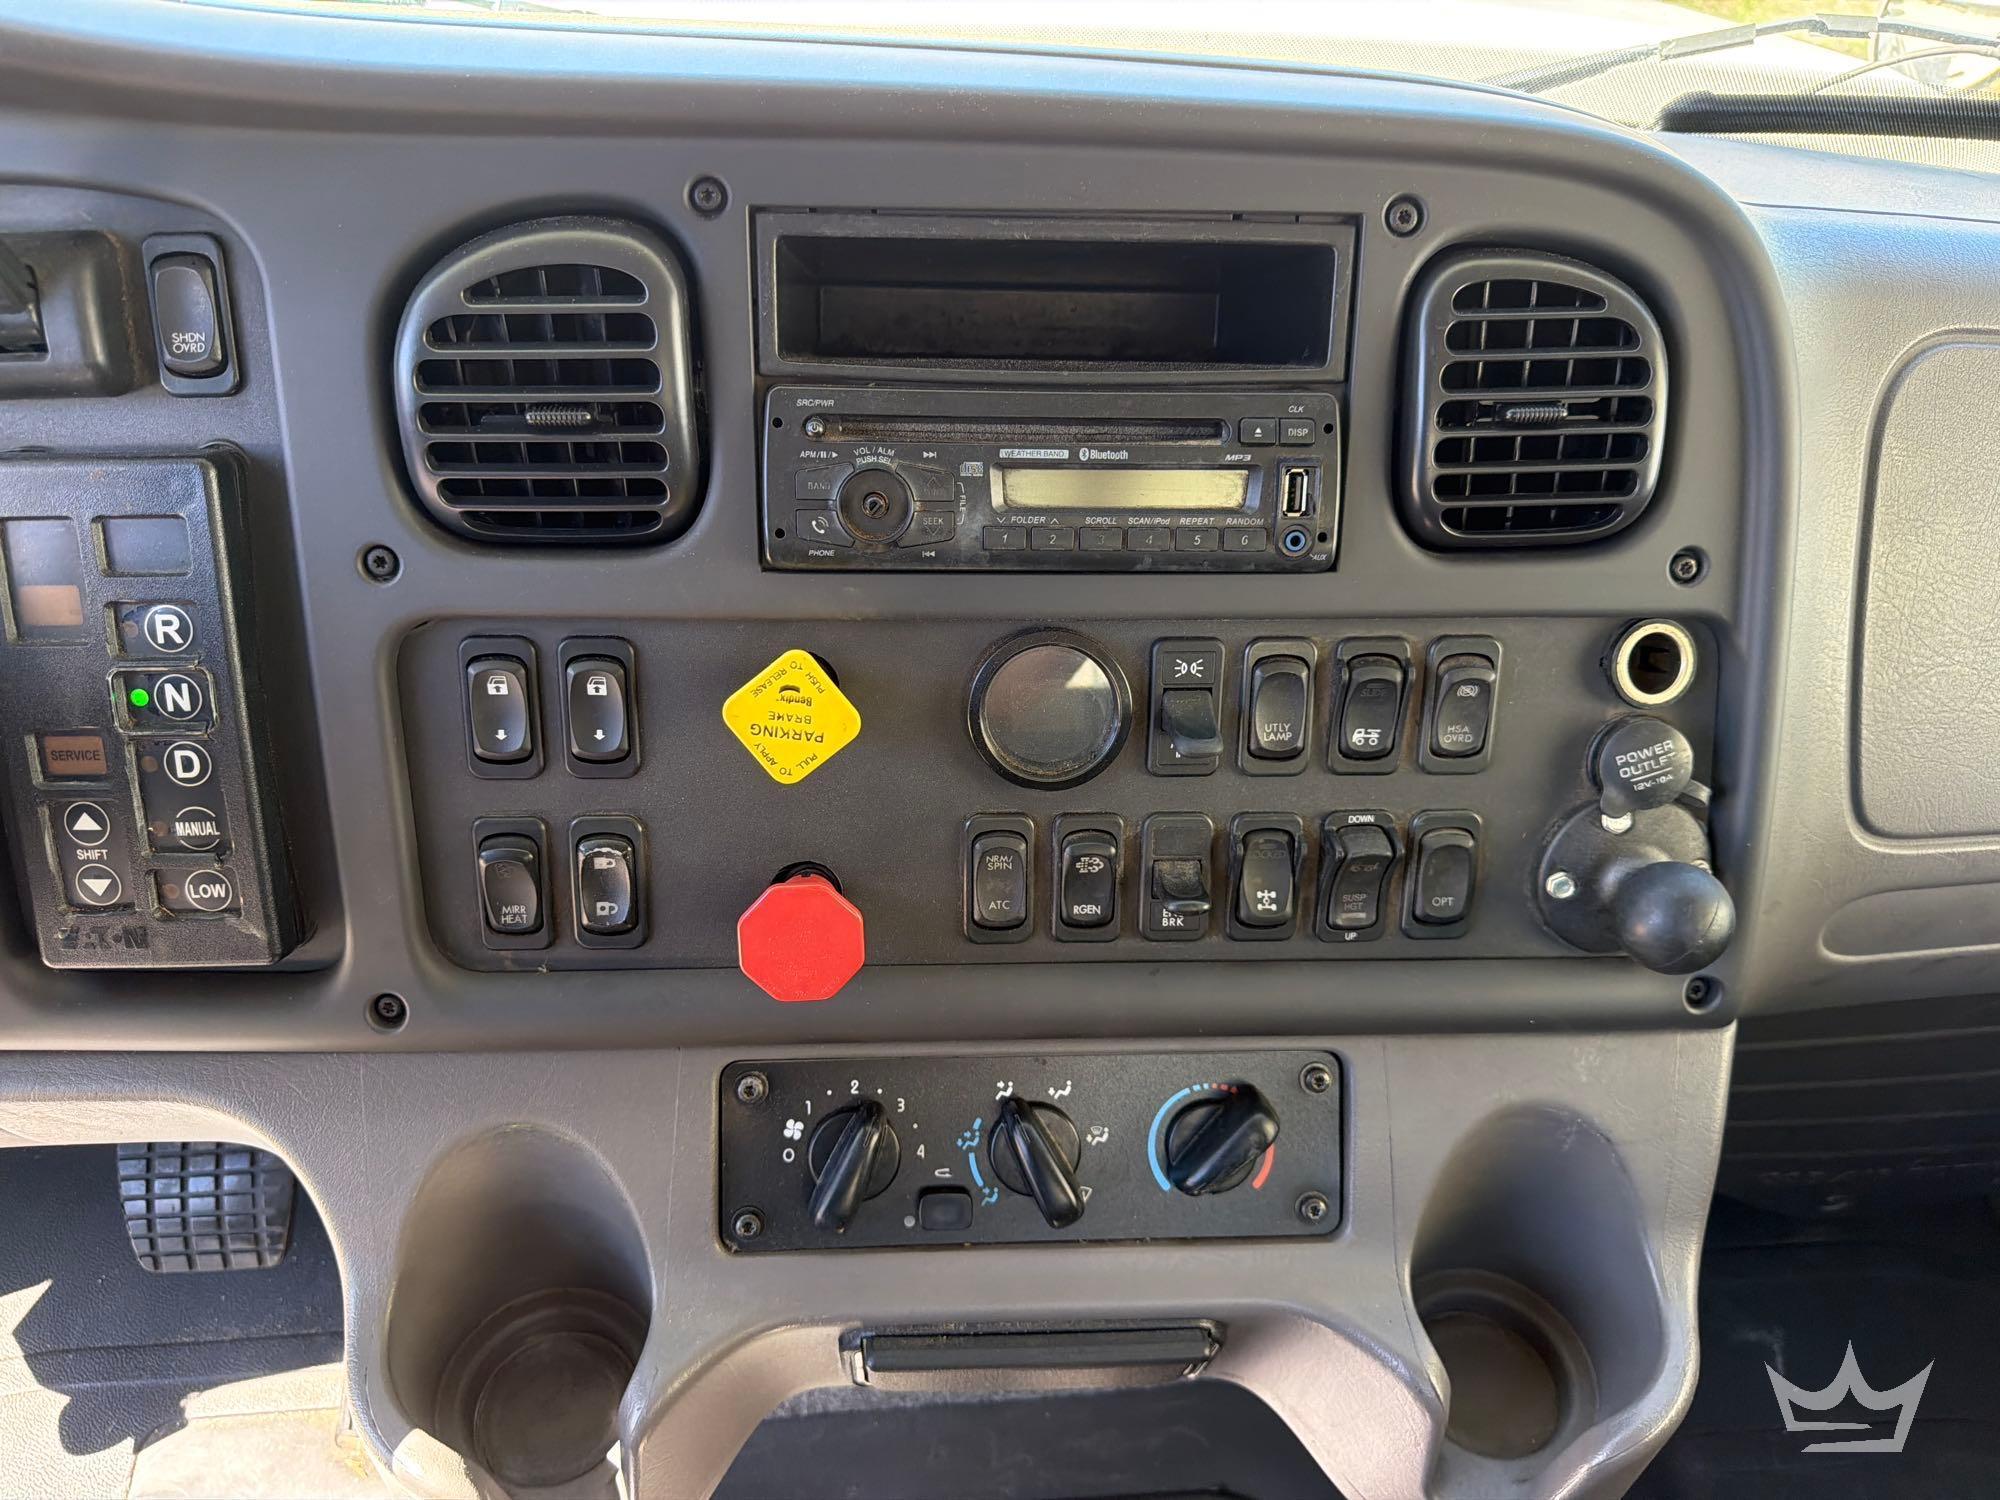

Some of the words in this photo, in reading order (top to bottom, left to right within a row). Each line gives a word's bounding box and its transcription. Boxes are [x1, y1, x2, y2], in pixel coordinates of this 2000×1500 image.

[172, 332, 205, 343] SHDN
[172, 342, 205, 353] OVRD
[796, 399, 834, 407] SRC/PWR
[1288, 405, 1304, 413] CLK
[1288, 428, 1308, 437] DISP
[853, 447, 871, 456] VOL
[877, 446, 896, 457] ALM
[1004, 450, 1041, 458] WEATHER
[1043, 450, 1064, 458] BAND
[1090, 449, 1128, 460] Bluetooth
[856, 455, 877, 464] PUSH
[878, 455, 892, 465] SEL
[1225, 454, 1252, 462] MP3
[808, 482, 831, 490] BAND
[923, 517, 944, 525] SEEK
[1010, 516, 1046, 524] FOLDER
[1085, 516, 1117, 525] SCROLL
[1127, 517, 1170, 525] SCAN/iPod
[1179, 517, 1215, 525] REPEAT
[1225, 517, 1264, 526] RANDOM
[1002, 534, 1008, 544] 1
[1049, 534, 1056, 545] 2
[1097, 534, 1105, 545] 3
[1145, 534, 1153, 545] 4
[1193, 534, 1201, 545] 5
[1241, 534, 1248, 546] 6
[154, 614, 184, 645] R
[790, 660, 804, 671] TO
[750, 668, 788, 698] RELEASE
[805, 672, 825, 694] PUSH
[164, 684, 192, 712] N
[779, 694, 812, 706] Bendix
[768, 711, 812, 724] BRAKE
[1264, 723, 1291, 732] UTLY
[1447, 724, 1470, 734] HSA
[750, 723, 824, 743] PARKING
[1263, 731, 1292, 741] LAMP
[1443, 733, 1473, 743] OVRD
[51, 749, 101, 762] SERVICE
[754, 743, 778, 766] APPLY
[1615, 740, 1674, 766] POWER
[175, 751, 200, 777] D
[795, 753, 818, 770] PULL
[779, 767, 793, 776] TO
[1348, 815, 1374, 823] DOWN
[176, 821, 220, 837] MANUAL
[77, 849, 108, 861] SHIFT
[986, 855, 1013, 864] NRM/
[987, 862, 1013, 870] SPIN
[189, 883, 226, 898] LOW
[1343, 893, 1367, 903] SUSP
[1432, 897, 1455, 907] OPT
[502, 905, 526, 914] MIRR
[988, 900, 1010, 910] ATC
[1073, 905, 1101, 915] RGEN
[1344, 902, 1363, 911] HGT
[501, 914, 528, 924] HEAT
[1162, 917, 1184, 927] BRK
[1344, 932, 1358, 941] UP
[850, 1080, 859, 1095] 2
[805, 1100, 811, 1115] 1
[897, 1098, 905, 1112] 3
[916, 1144, 925, 1159] 4
